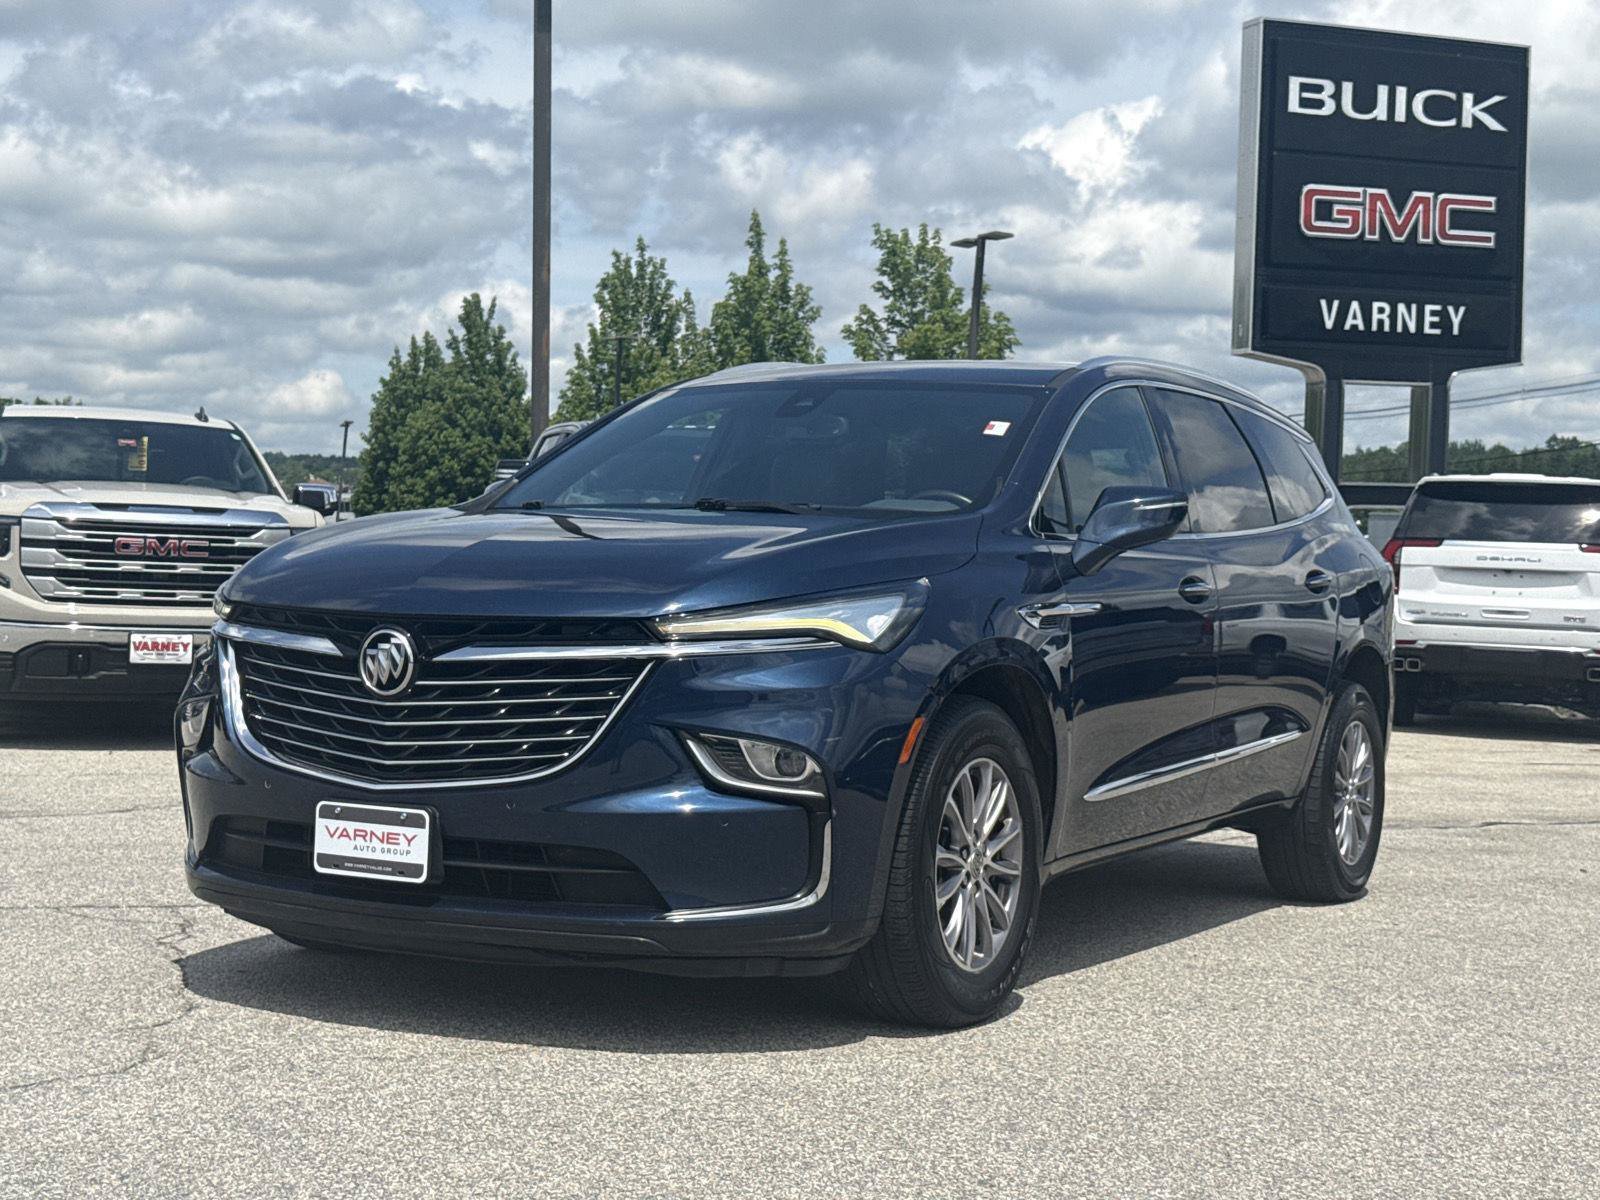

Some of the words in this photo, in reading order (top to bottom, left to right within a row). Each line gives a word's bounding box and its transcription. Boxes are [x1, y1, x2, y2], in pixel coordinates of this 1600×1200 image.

[1287, 75, 1509, 133] BUICK
[1299, 183, 1497, 249] GMC
[1319, 298, 1466, 336] VARNEY
[114, 536, 210, 559] GMC
[132, 640, 191, 653] VARNEY
[325, 825, 417, 847] VARNEY
[353, 844, 377, 854] AUTO
[380, 847, 412, 857] GROUP
